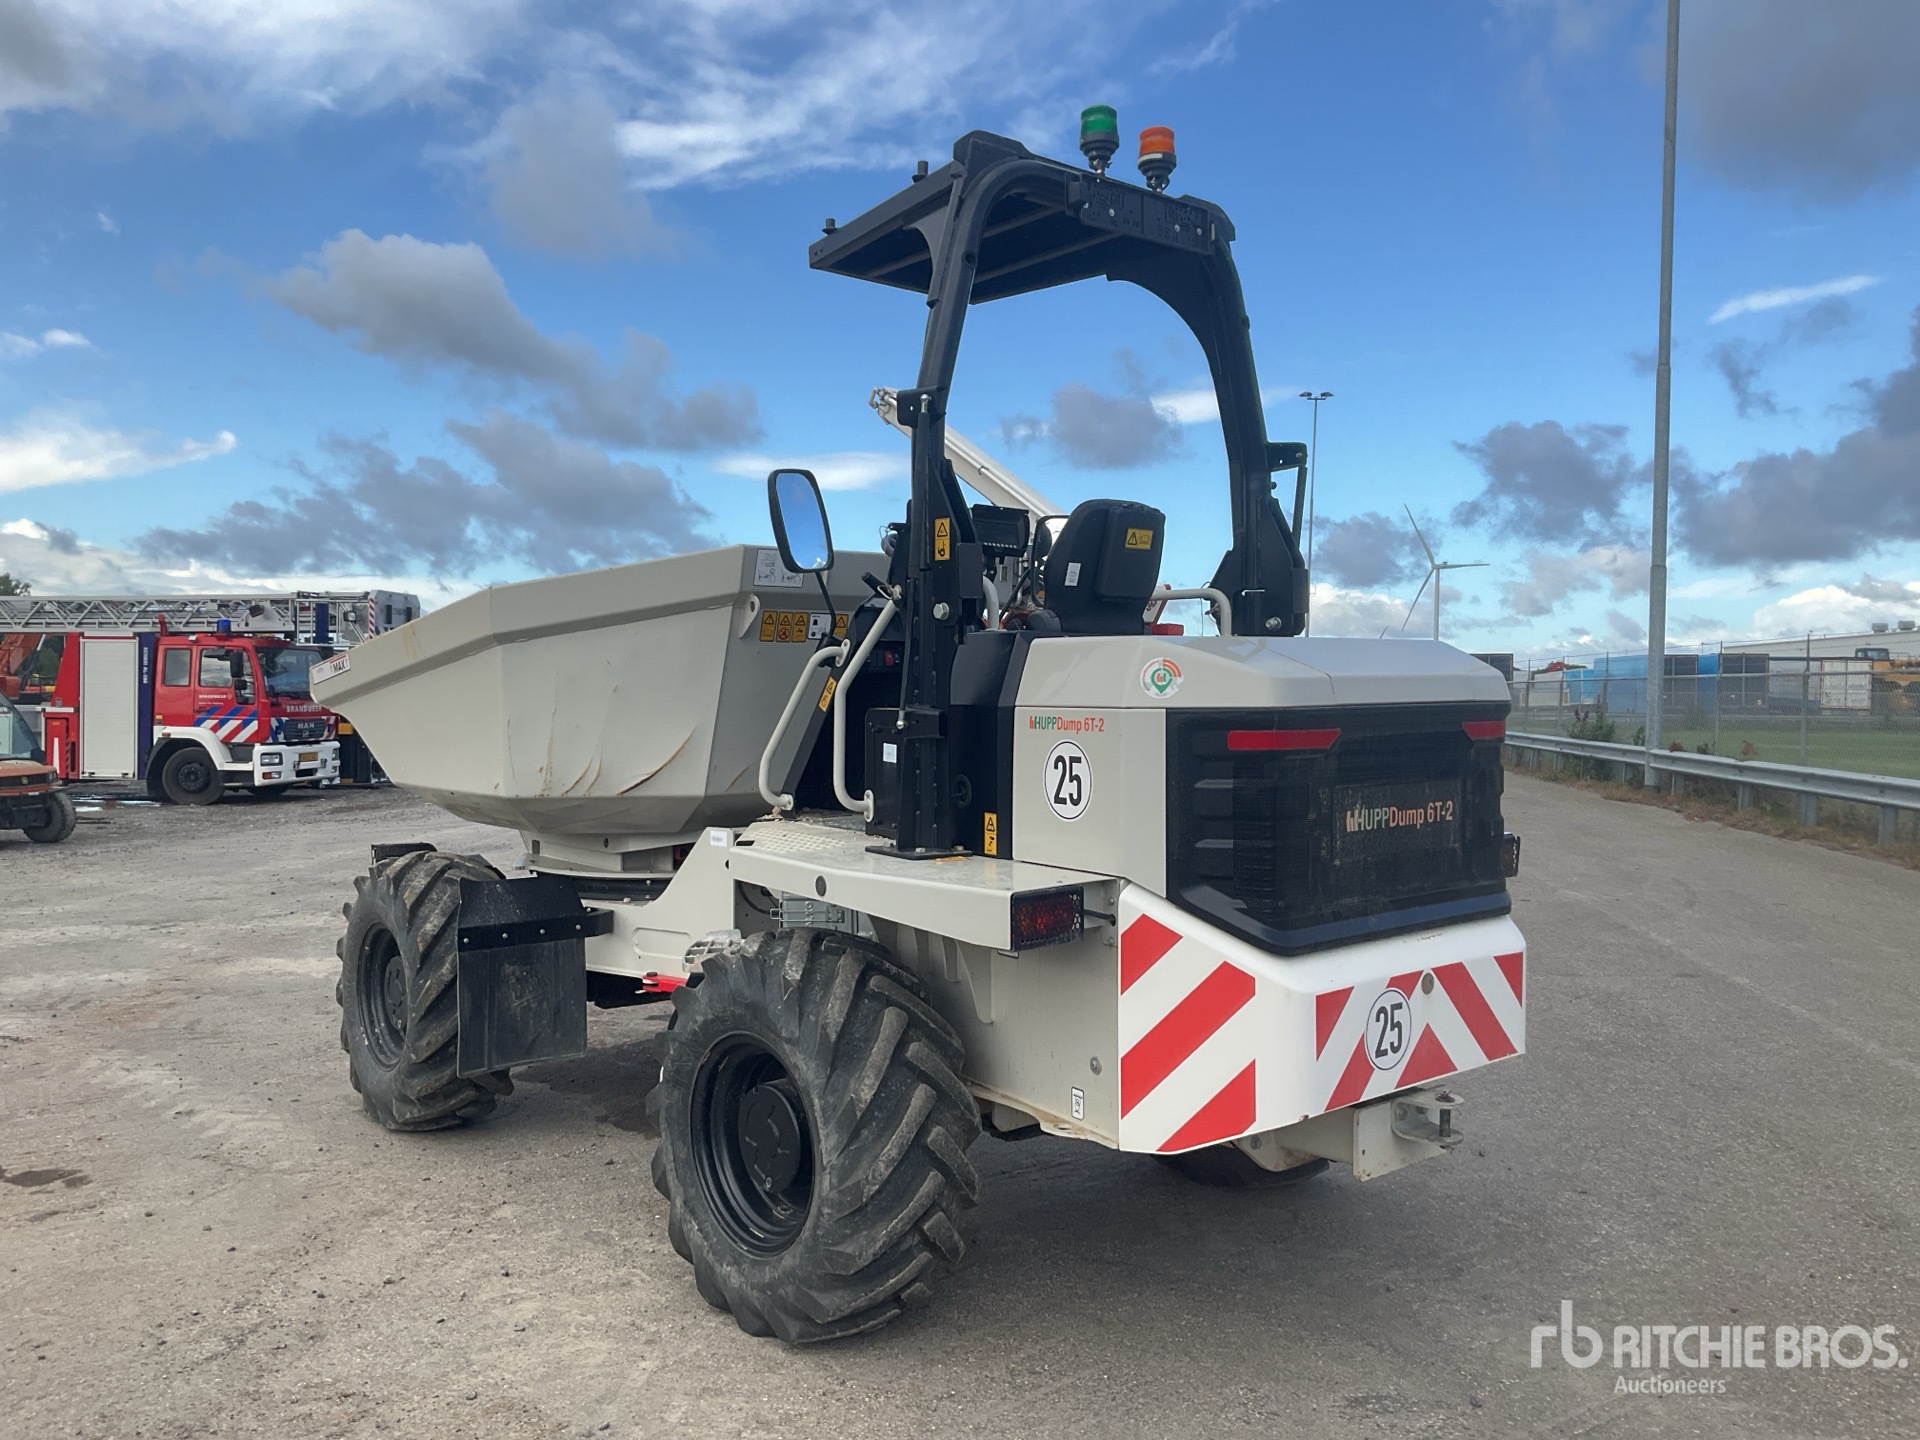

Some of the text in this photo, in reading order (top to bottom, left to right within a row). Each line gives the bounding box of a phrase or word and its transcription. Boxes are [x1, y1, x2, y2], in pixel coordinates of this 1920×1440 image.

[333, 659, 346, 673] MAX
[1083, 717, 1105, 733] 6T-2
[1053, 754, 1082, 807] 25
[1427, 800, 1453, 823] 6T-2
[1374, 1001, 1404, 1059] 25
